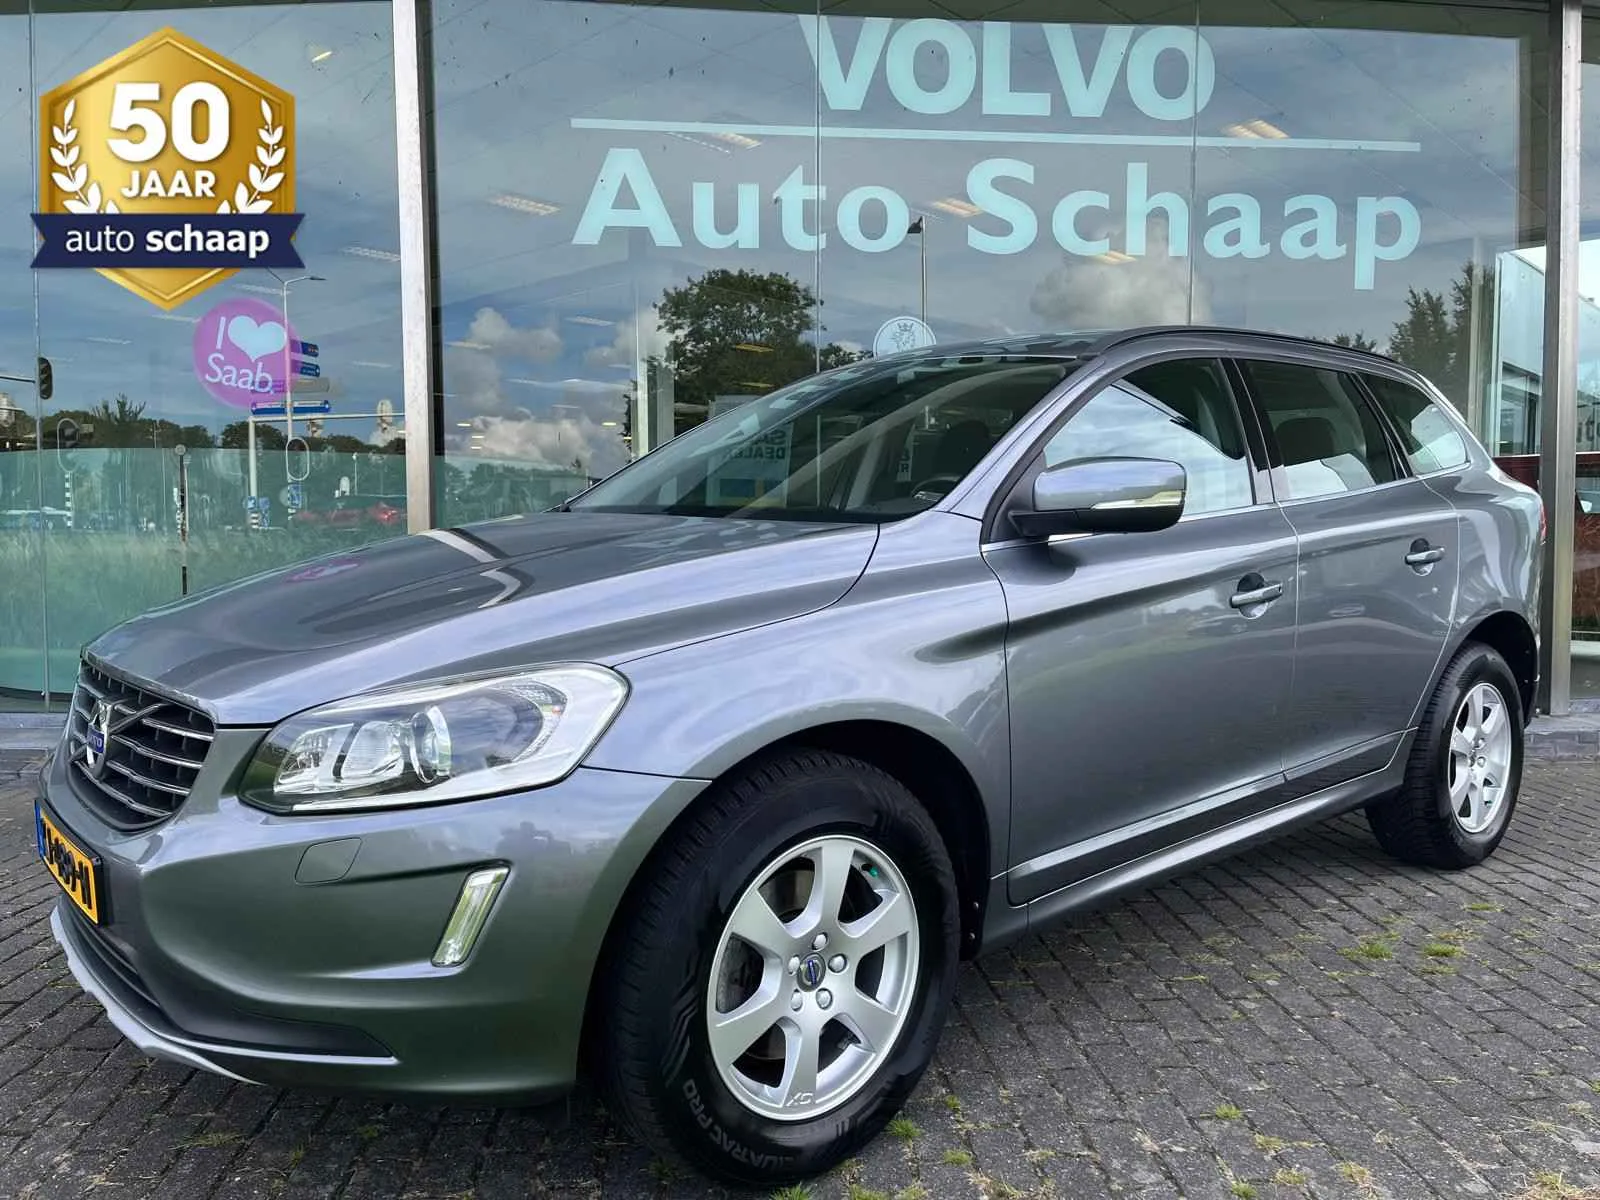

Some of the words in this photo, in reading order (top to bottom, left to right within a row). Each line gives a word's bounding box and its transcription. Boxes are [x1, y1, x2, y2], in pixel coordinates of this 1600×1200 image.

[798, 15, 1216, 121] VOLVO
[572, 148, 910, 253] Auto
[966, 158, 1422, 290] Schaap
[216, 316, 226, 350] I
[682, 1078, 713, 1129] PRO
